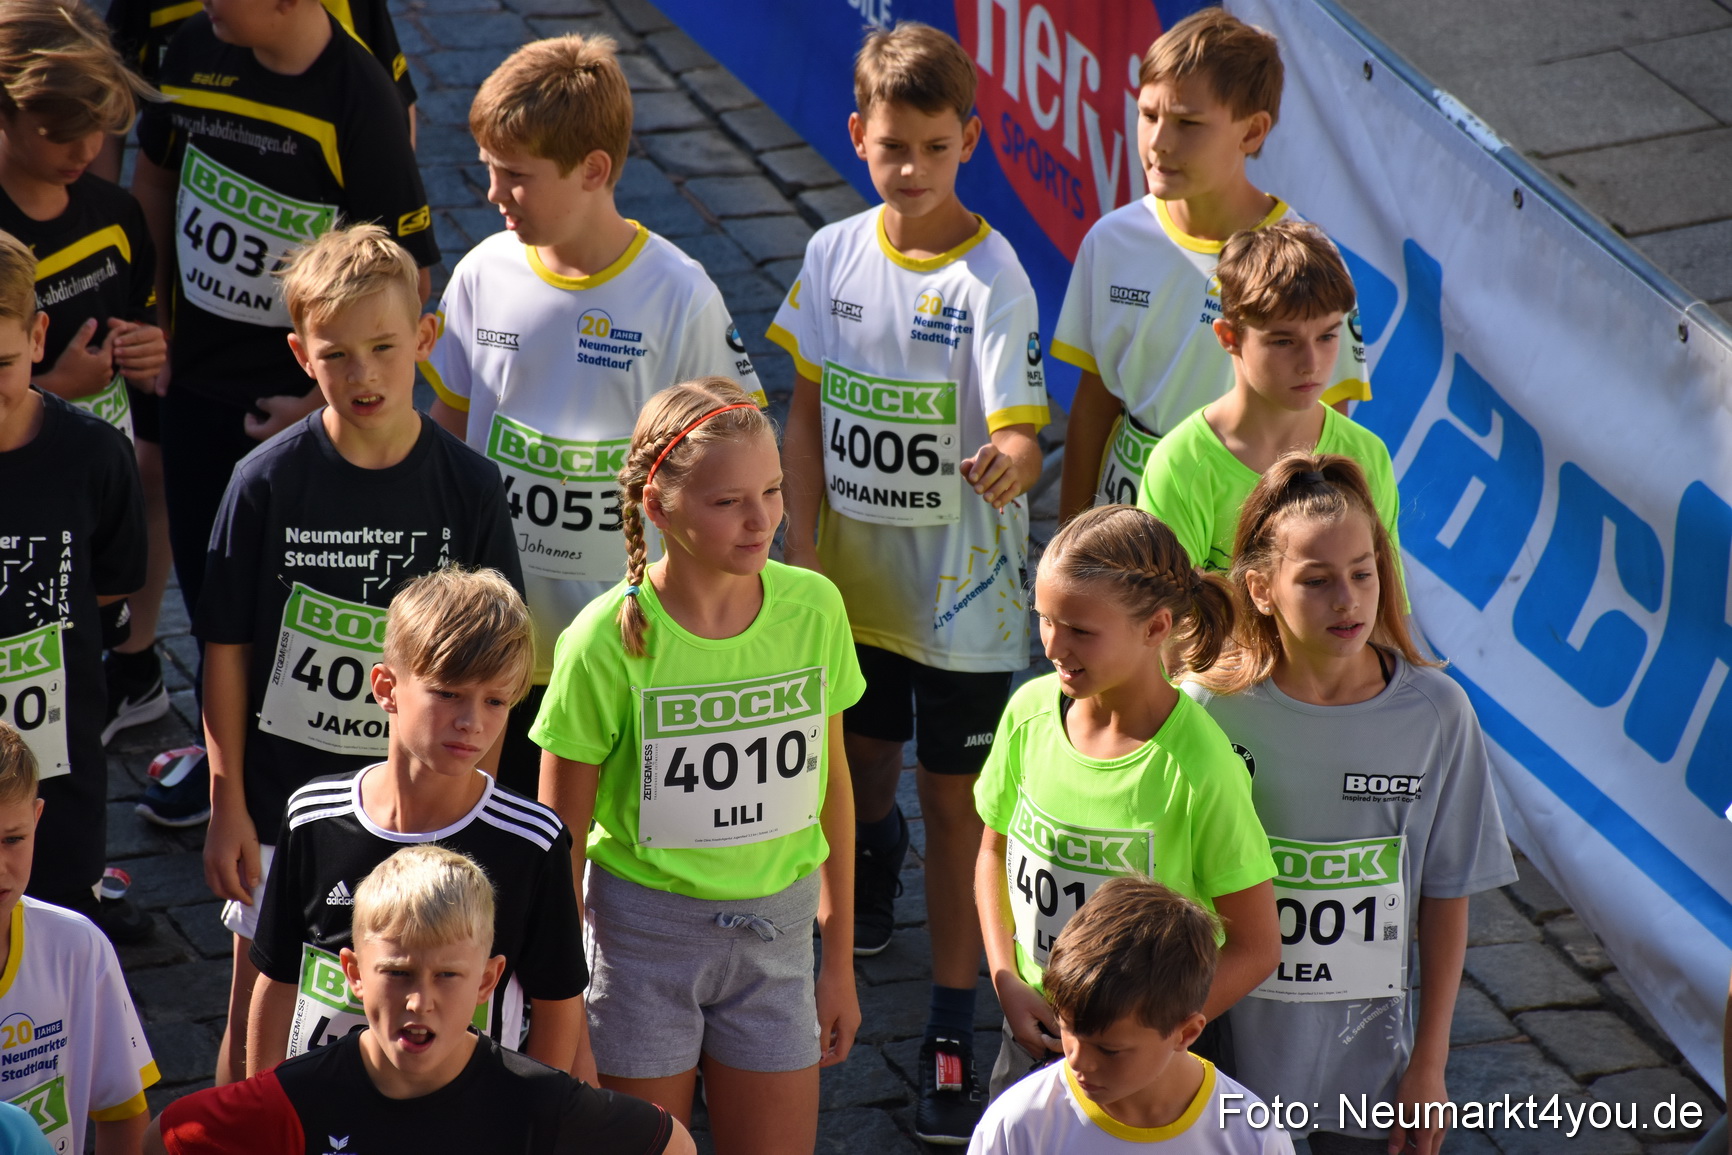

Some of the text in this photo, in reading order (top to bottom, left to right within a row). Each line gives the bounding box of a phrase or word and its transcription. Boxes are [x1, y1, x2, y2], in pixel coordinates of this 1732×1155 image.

[1002, 112, 1085, 220] SPORTS
[190, 157, 316, 239] BOCK
[186, 267, 272, 312] JULIAN
[1110, 285, 1150, 304] BOCK
[917, 294, 942, 316] 20
[477, 329, 519, 347] BOCK
[580, 315, 610, 338] 20
[611, 329, 641, 341] JAHRE
[578, 338, 648, 356] Neumarkter
[576, 352, 633, 372] Stadtlauf
[828, 365, 944, 420] BOCK
[497, 423, 629, 478] BOCK
[830, 417, 940, 477] 4006
[503, 475, 624, 532] 4053
[829, 474, 942, 509] JOHANNES
[285, 527, 404, 545] Neumarkter
[517, 533, 582, 560] Johannes
[284, 550, 379, 570] Stadtlauf
[953, 574, 995, 613] September
[993, 554, 1008, 577] 2019
[657, 676, 811, 732] BOCK
[308, 711, 389, 738] JAKO
[811, 729, 817, 738] J
[964, 732, 993, 748] JAKO
[664, 730, 807, 793] 4010
[1343, 773, 1425, 796] BOCK
[1342, 794, 1371, 803] inspired
[714, 802, 763, 828] LILI
[1015, 798, 1135, 872] BOCK
[1271, 844, 1388, 884] OCK
[1016, 855, 1086, 917] 401
[326, 895, 355, 906] adidas
[1389, 898, 1395, 907] J
[1276, 896, 1377, 945] 001
[1277, 963, 1332, 981] LEA
[36, 1022, 61, 1039] JAHRE
[1352, 1003, 1389, 1035] September
[1, 1020, 32, 1050] 20
[2, 1036, 67, 1066] Neumarkter
[1, 1055, 59, 1082] Stadtlauf
